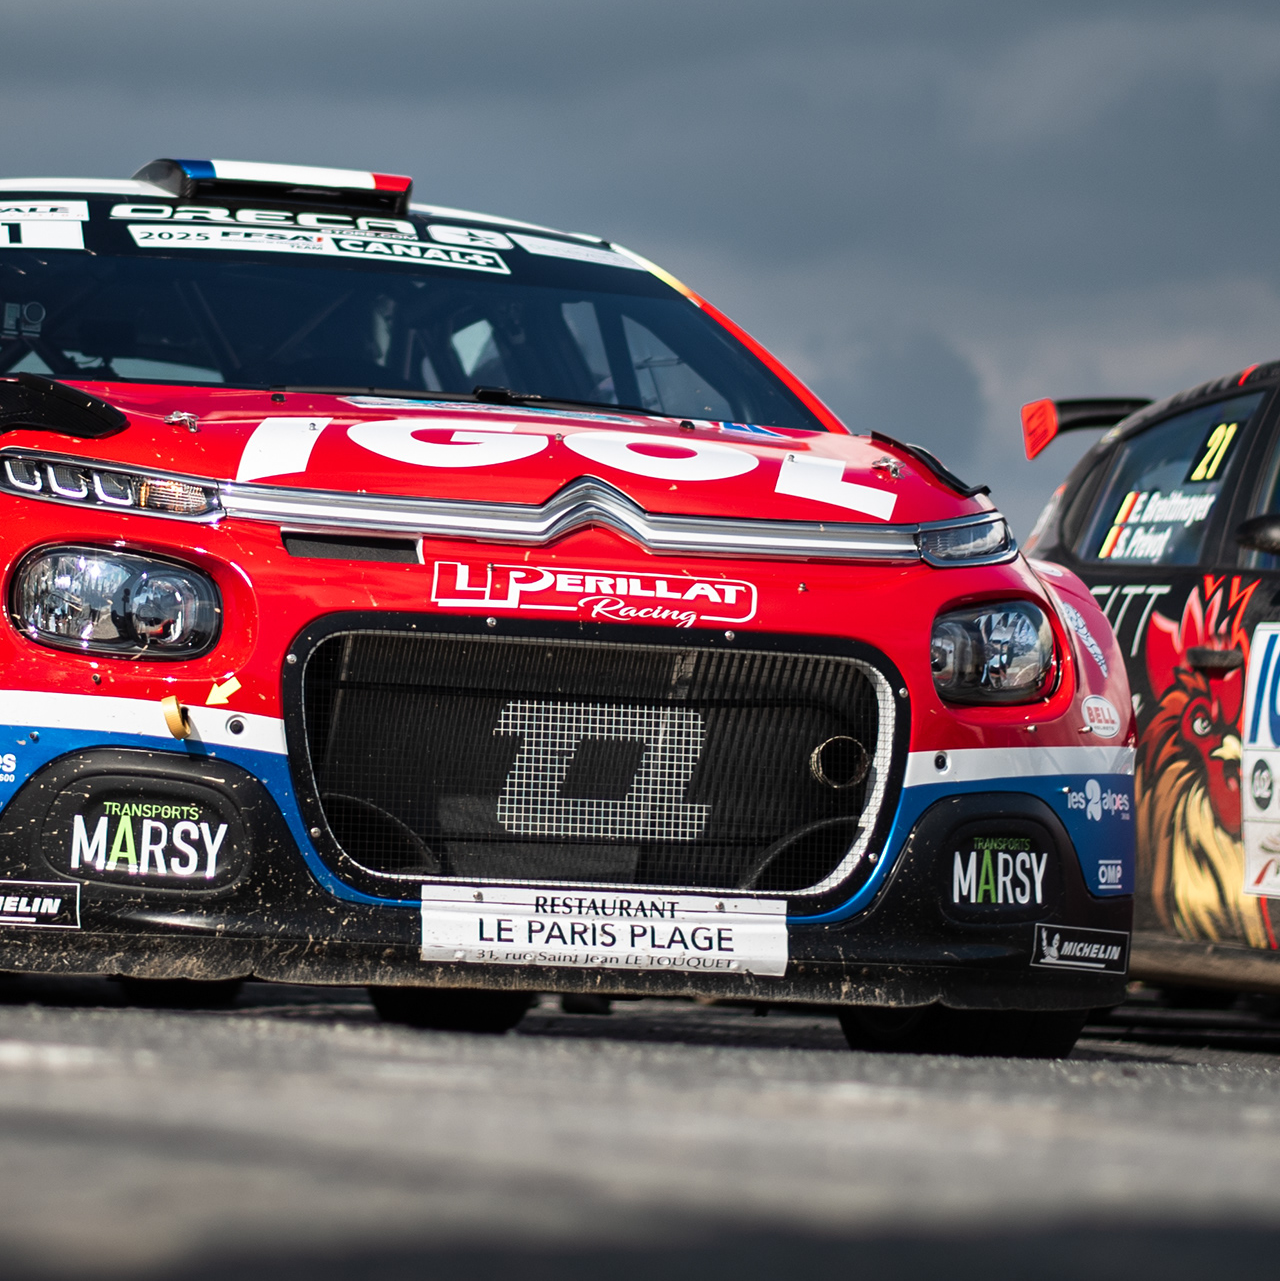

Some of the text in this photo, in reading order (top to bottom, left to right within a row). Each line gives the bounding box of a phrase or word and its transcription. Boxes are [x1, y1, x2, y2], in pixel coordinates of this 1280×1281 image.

[109, 203, 418, 235] ORECA
[1, 222, 22, 244] 1
[139, 231, 211, 241] 2025
[338, 239, 494, 265] CANAL+
[1190, 422, 1238, 481] 21
[235, 416, 898, 522] IGOL
[578, 596, 698, 628] Racing
[1091, 584, 1172, 658] ITT
[1086, 706, 1118, 725] BELL
[103, 801, 199, 820] TRANSPORTS
[1085, 779, 1102, 821] 2
[1102, 789, 1130, 815] alpes
[71, 814, 228, 879] MARSY
[973, 837, 1031, 851] TRANSPORTS
[953, 848, 1048, 904] MARSY
[1098, 864, 1122, 884] OMP
[535, 895, 679, 919] RESTAURANT
[479, 917, 735, 953] LE PARIS PLAGE
[505, 953, 533, 962] rue
[537, 951, 579, 965] Saint
[582, 952, 619, 966] Jean
[625, 954, 643, 966] LE
[650, 955, 736, 970] TOUQUET
[1060, 941, 1122, 961] MICHELIN
